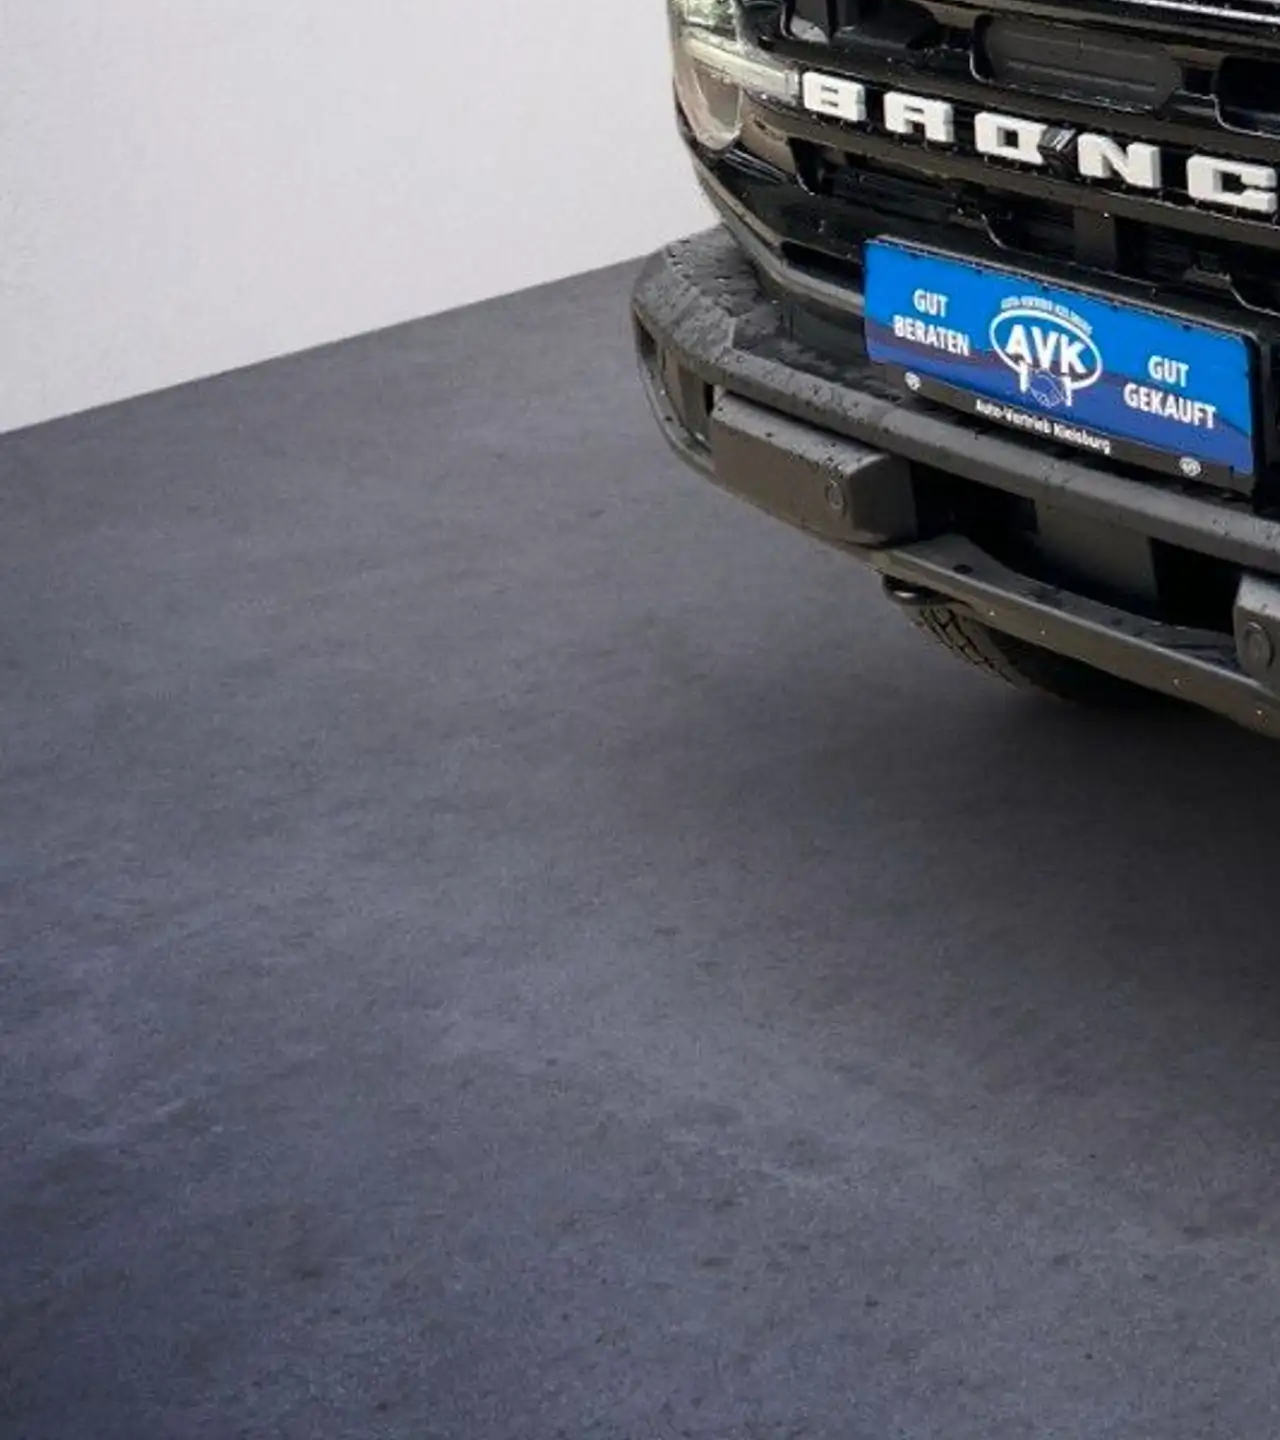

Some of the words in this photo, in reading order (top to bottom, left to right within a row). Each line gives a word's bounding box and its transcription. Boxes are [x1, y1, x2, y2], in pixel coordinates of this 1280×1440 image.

[913, 288, 949, 318] GUT
[893, 314, 971, 357] BERATEN
[1005, 323, 1087, 374] AVK
[1147, 354, 1190, 389] GUT
[1123, 381, 1217, 430] GEKAUFT
